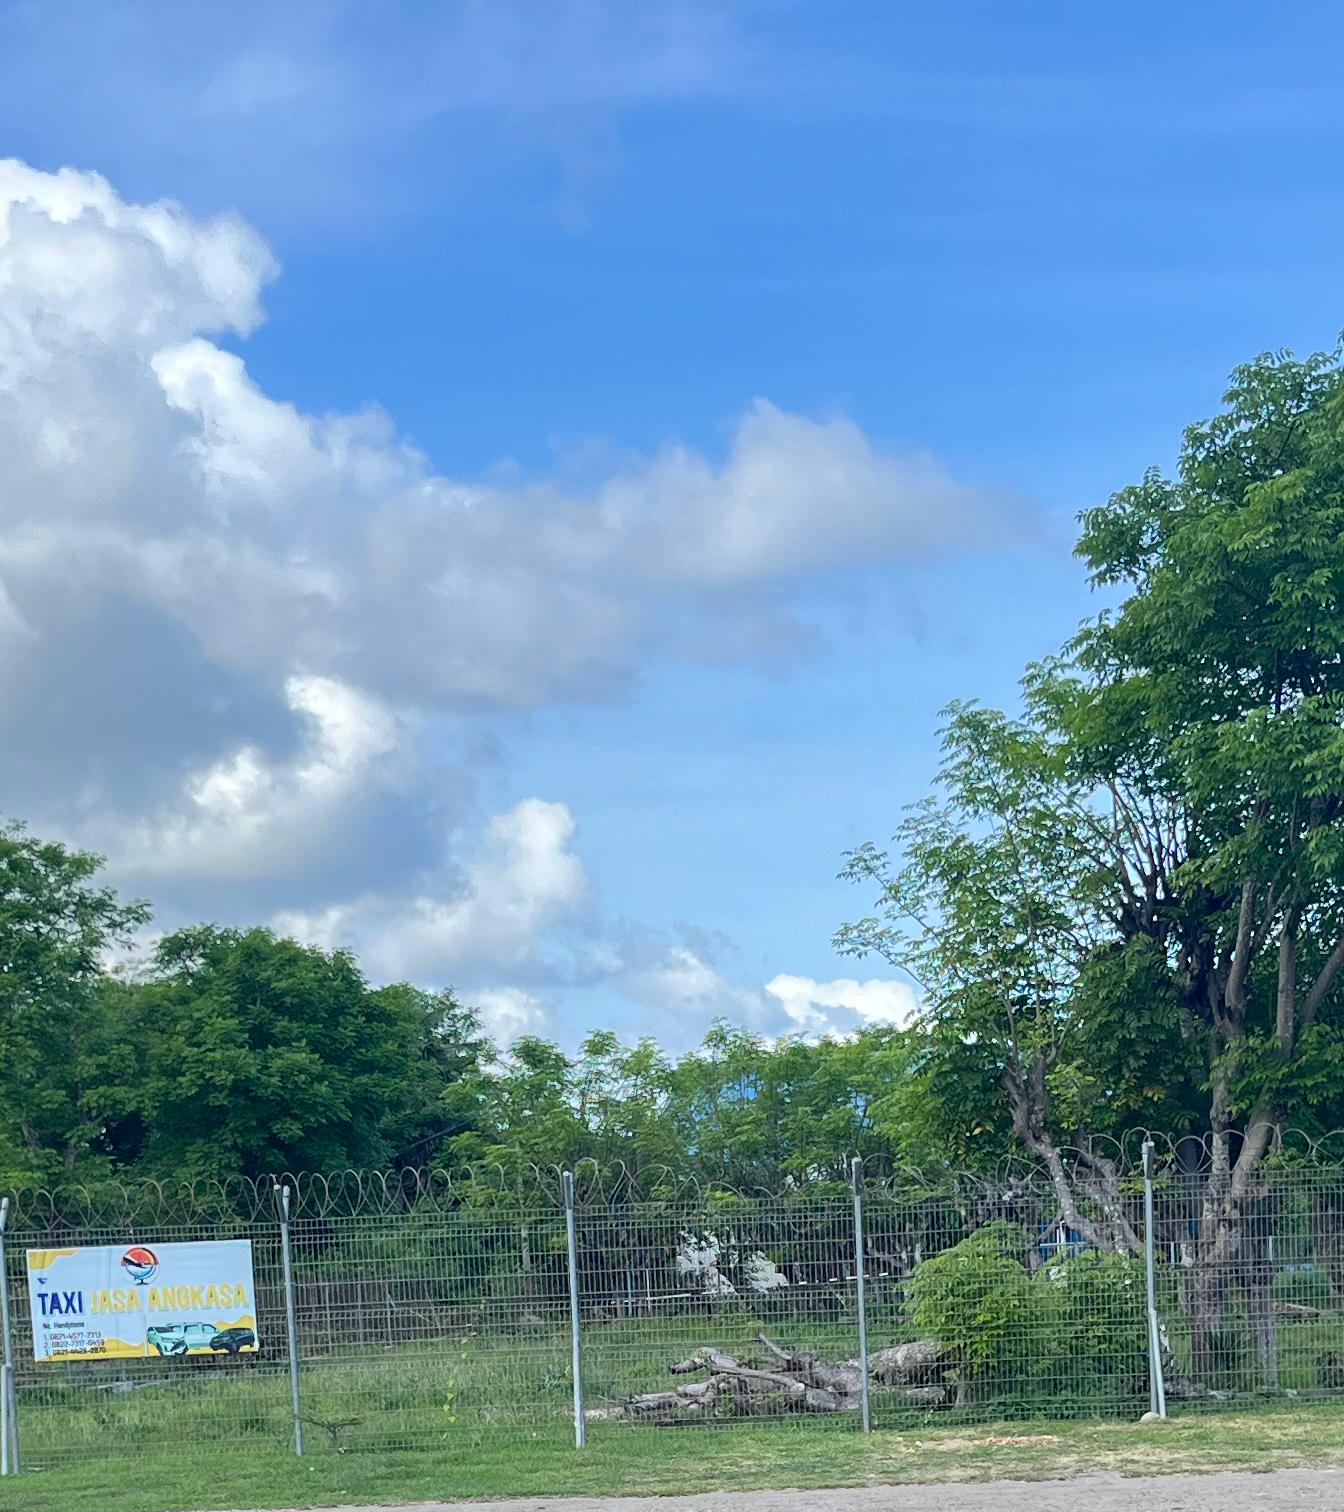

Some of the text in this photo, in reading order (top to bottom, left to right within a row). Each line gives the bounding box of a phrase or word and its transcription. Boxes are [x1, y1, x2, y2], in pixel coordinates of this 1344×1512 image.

[38, 1284, 250, 1315] TAXI JASA ANGKASA
